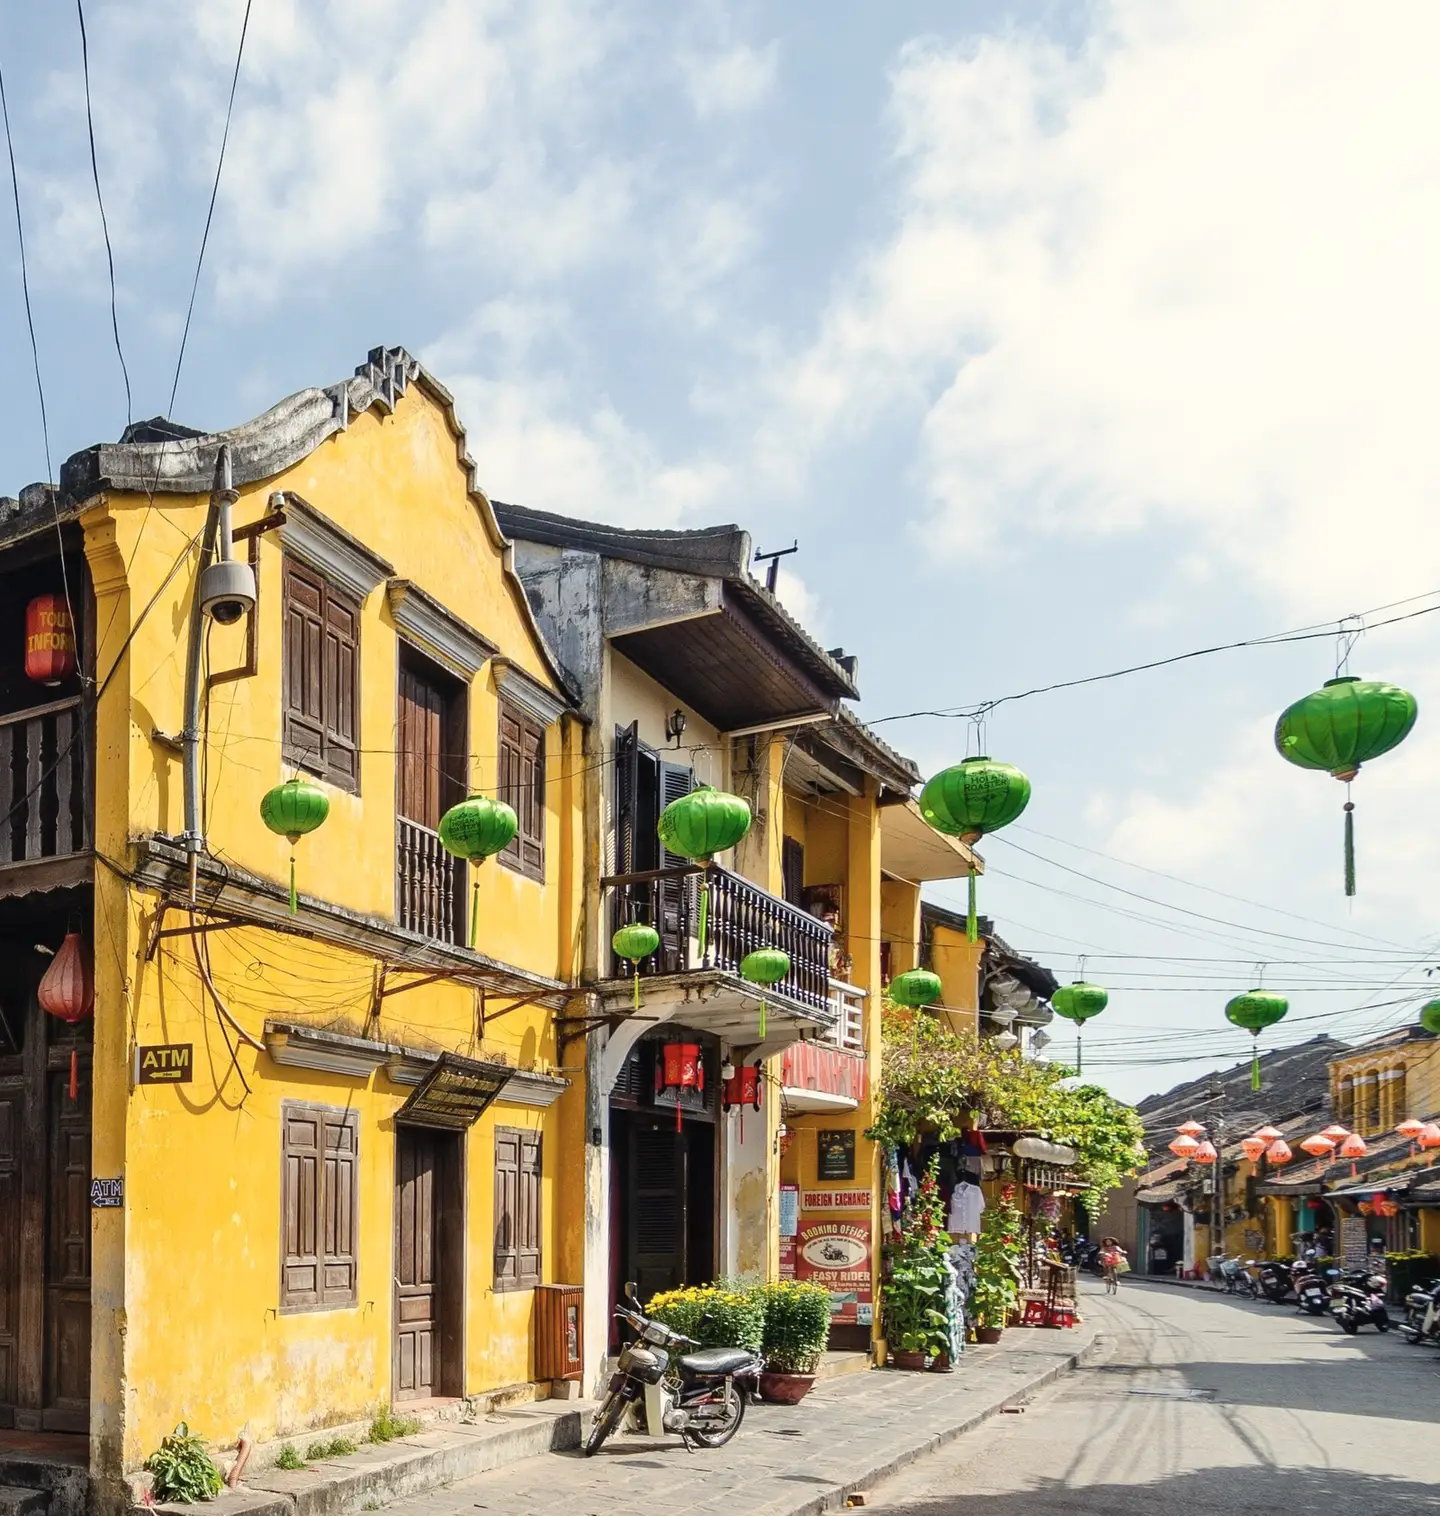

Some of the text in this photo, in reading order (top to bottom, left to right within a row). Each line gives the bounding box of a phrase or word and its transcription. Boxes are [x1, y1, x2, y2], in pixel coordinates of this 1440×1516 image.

[142, 1049, 189, 1069] ATM
[91, 1180, 124, 1197] ATM
[804, 1192, 870, 1207] FOREIGN EXCHANGE
[801, 1223, 869, 1241] BOOKING OFFICE
[812, 1271, 871, 1281] EASY RIDER
